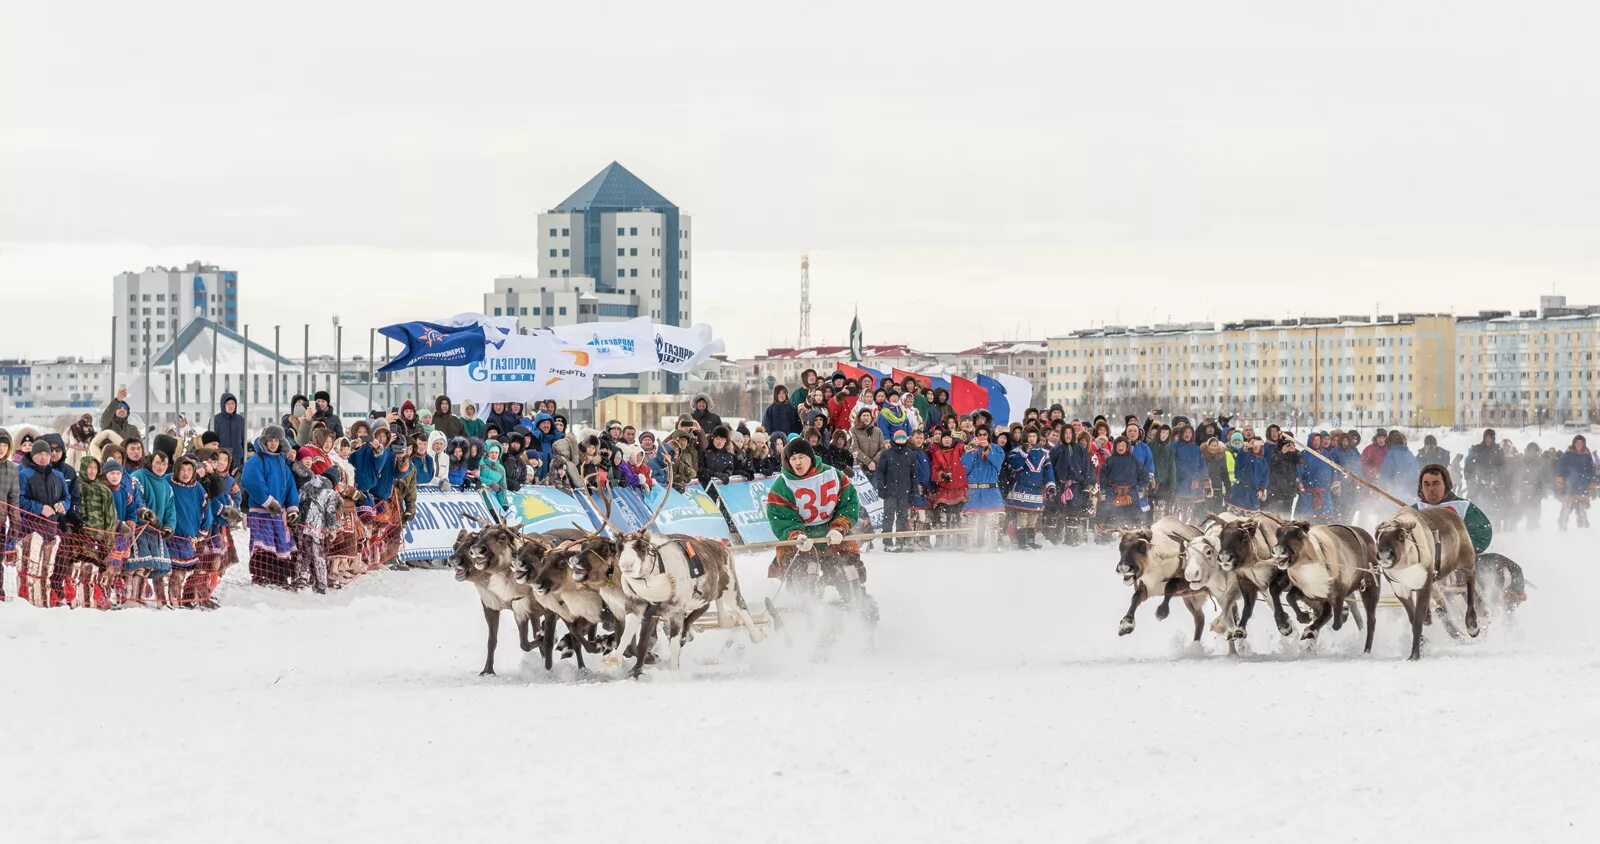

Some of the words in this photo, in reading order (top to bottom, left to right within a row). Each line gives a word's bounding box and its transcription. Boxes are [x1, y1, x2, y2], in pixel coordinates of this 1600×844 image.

[665, 342, 695, 360] ГАЗПРО
[490, 357, 536, 371] ГАЗПРОМ
[794, 479, 837, 523] 35
